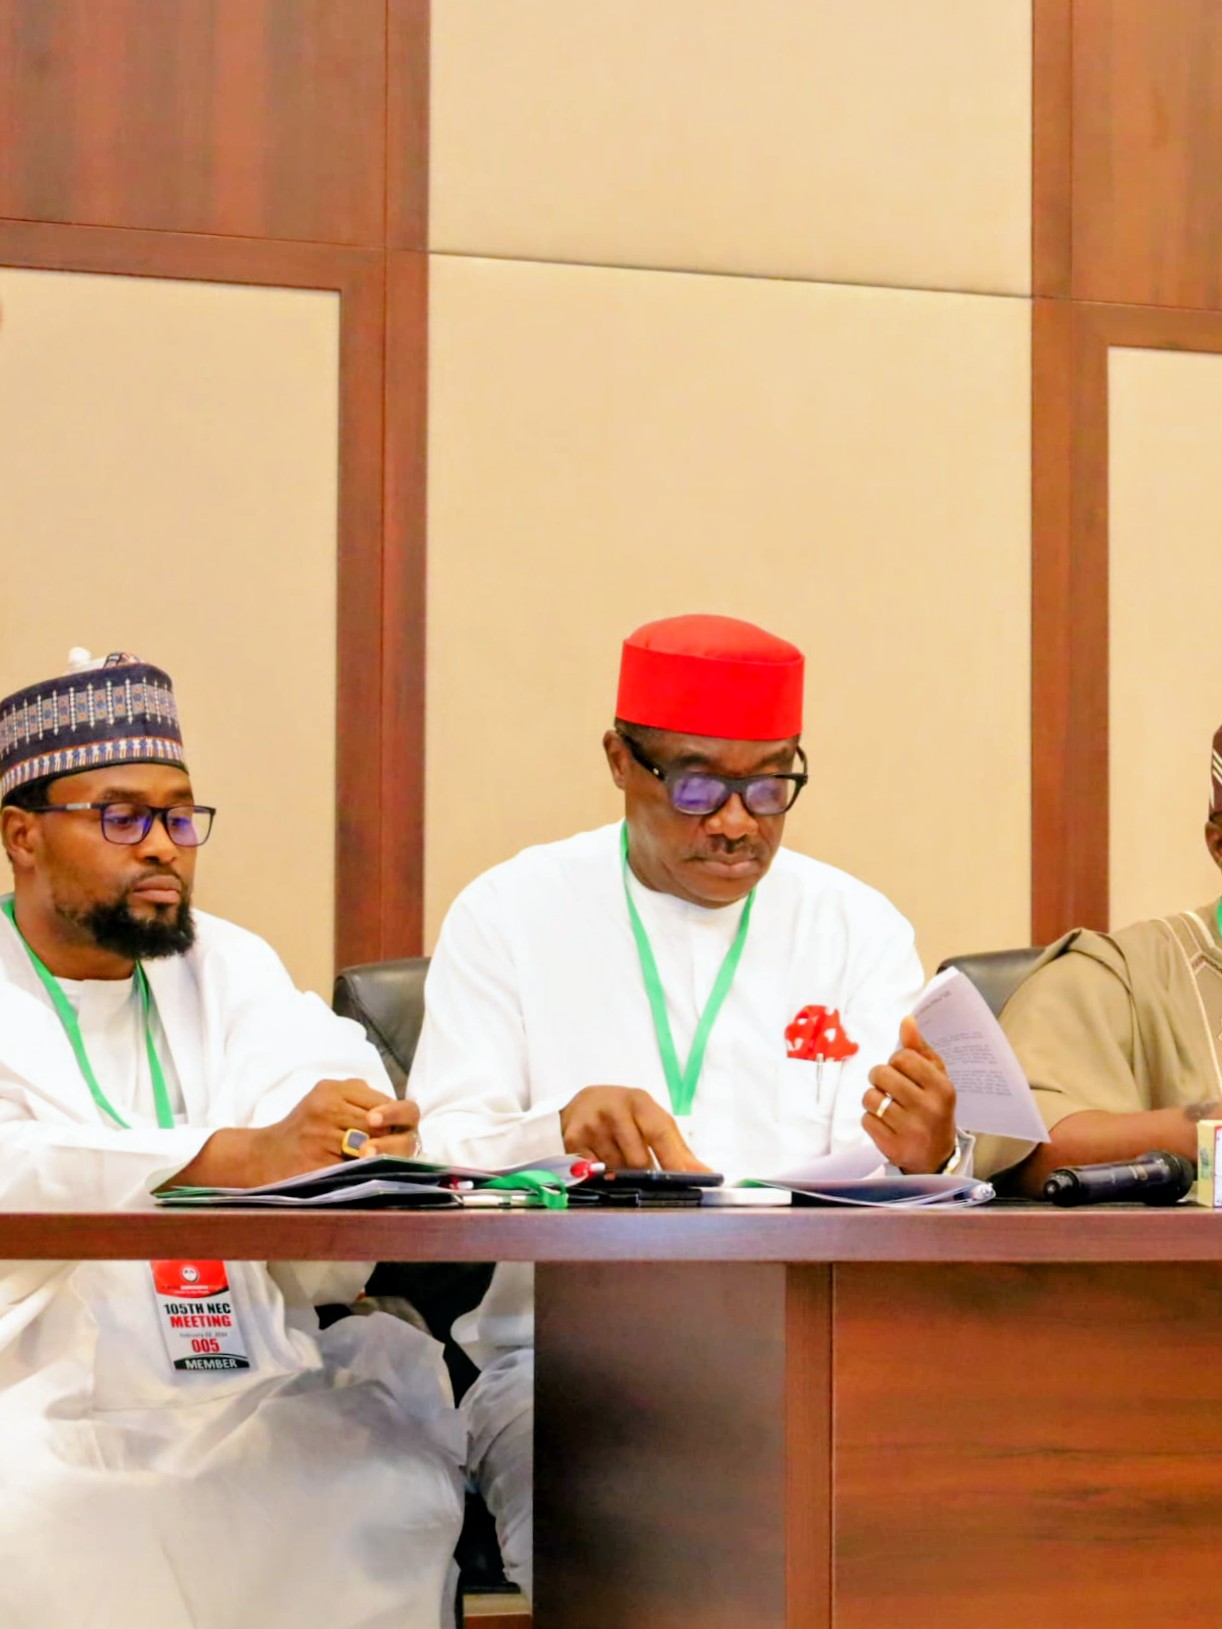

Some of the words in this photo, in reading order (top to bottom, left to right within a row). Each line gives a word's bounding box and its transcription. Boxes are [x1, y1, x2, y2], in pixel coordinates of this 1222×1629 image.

[164, 1303, 204, 1315] 105TH
[207, 1303, 231, 1314] NEC
[170, 1315, 232, 1328] MEETING
[191, 1338, 220, 1353] 005
[184, 1359, 238, 1370] MEMBER
